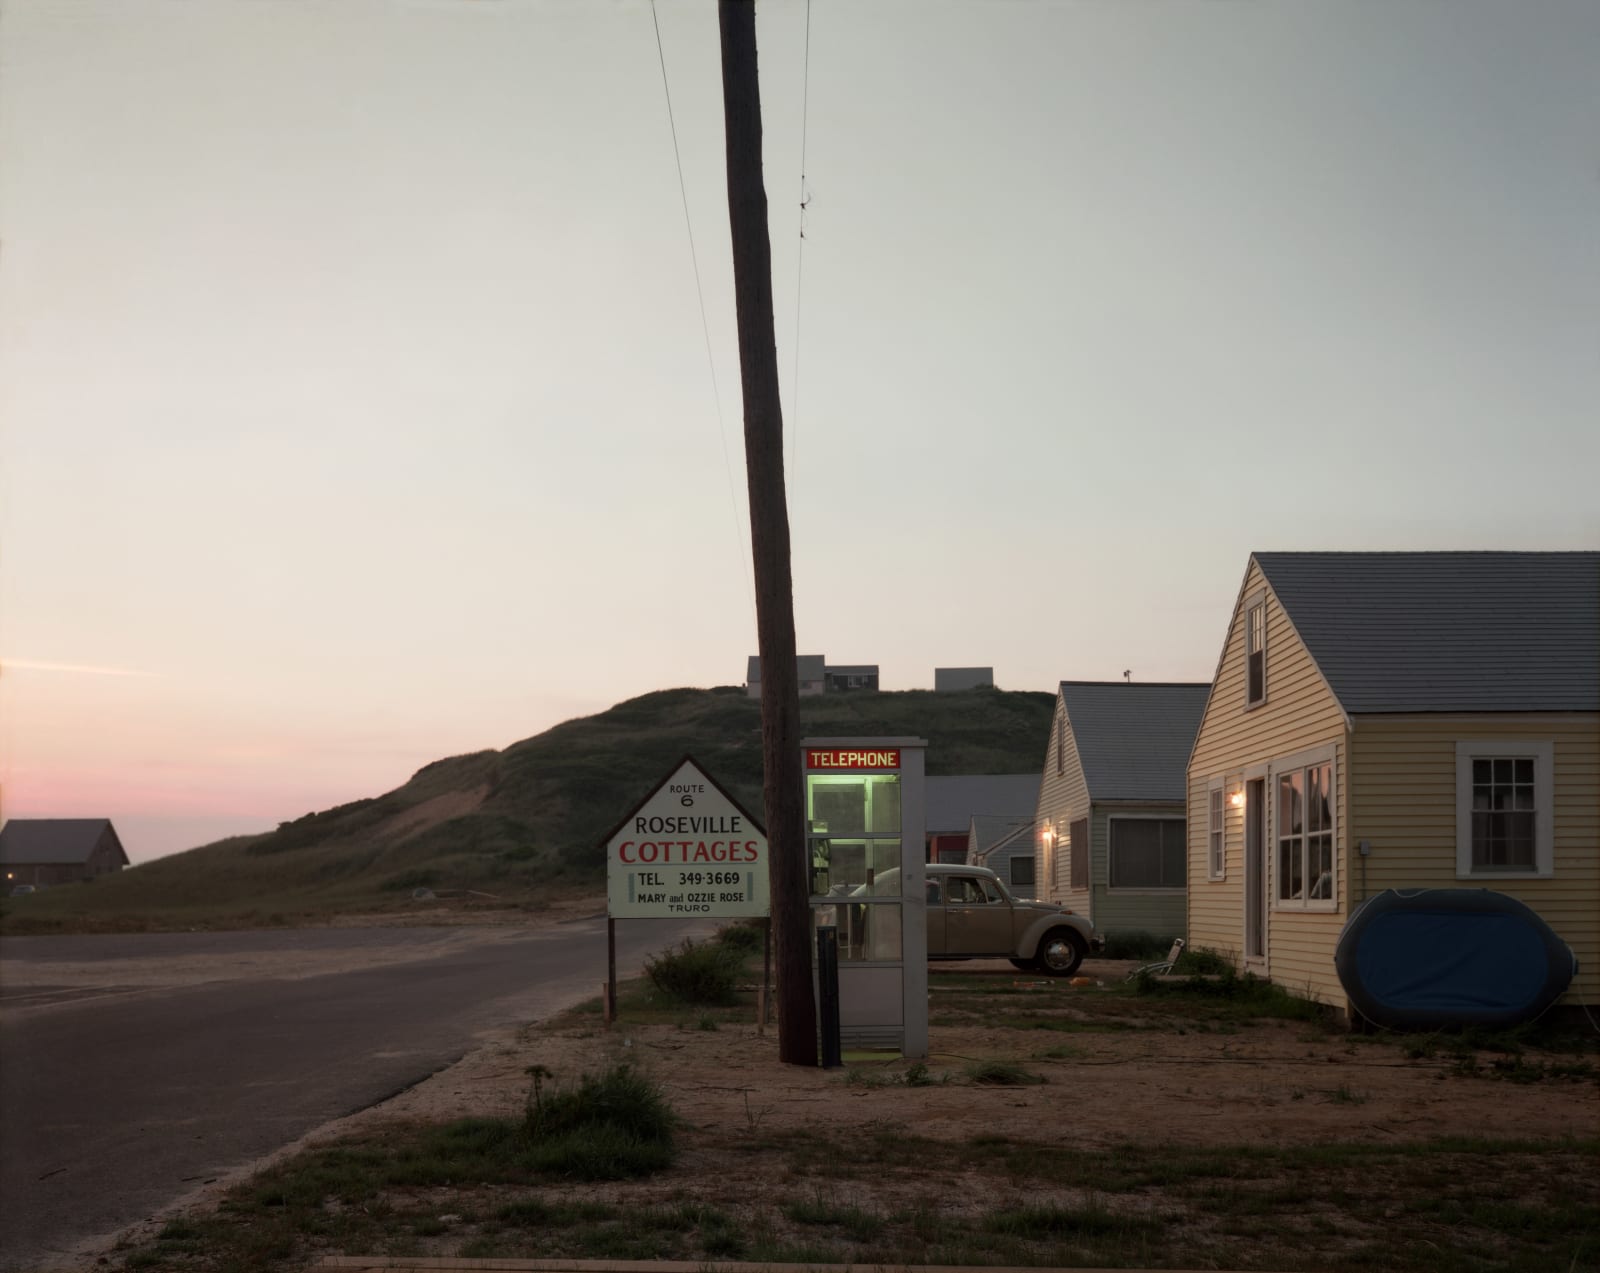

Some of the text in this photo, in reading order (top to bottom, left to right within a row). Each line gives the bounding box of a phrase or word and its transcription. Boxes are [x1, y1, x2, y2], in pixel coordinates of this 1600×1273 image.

[811, 752, 896, 766] TELEPHONE
[670, 785, 704, 793] ROUTE
[681, 795, 693, 807] 6
[636, 817, 741, 833] ROSEVILLE
[619, 841, 758, 863] COTTAGES
[638, 873, 664, 885] TEL.
[638, 893, 744, 903] MARY and OZZIE ROSE
[668, 904, 710, 912] TRURO
